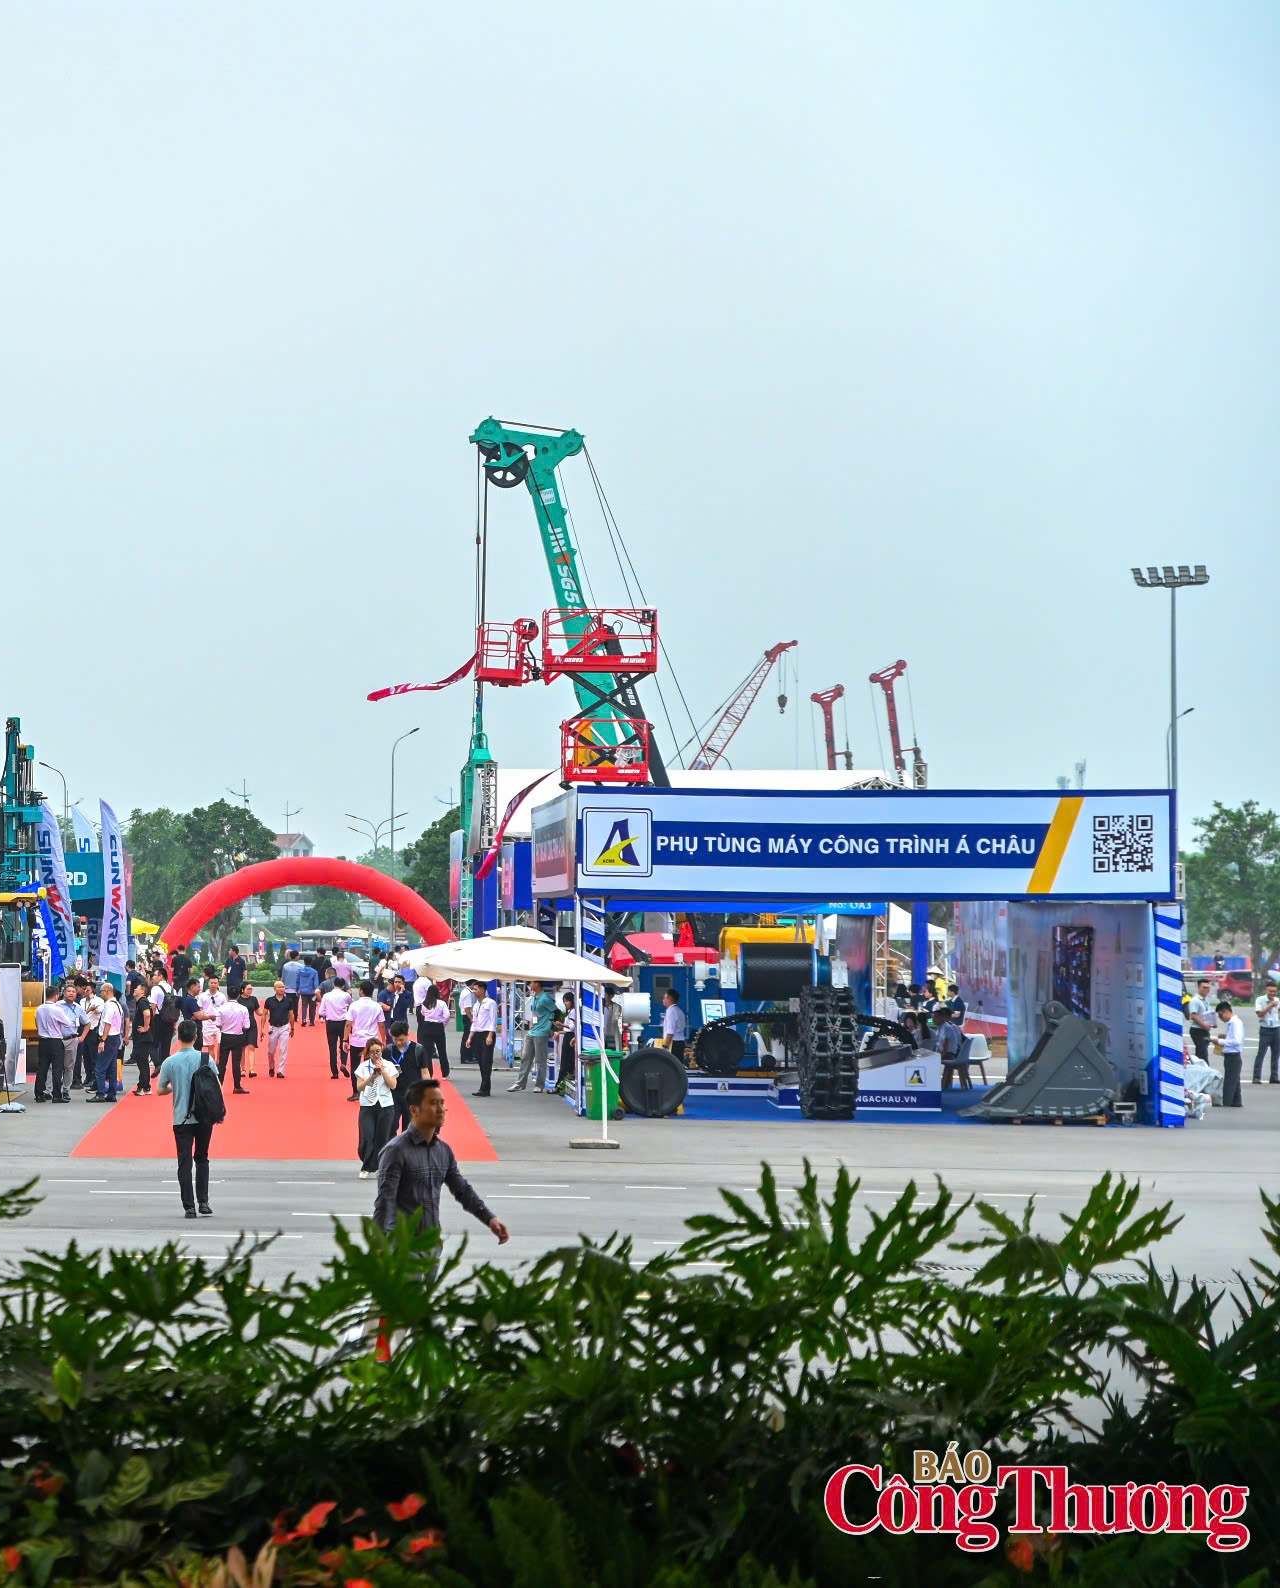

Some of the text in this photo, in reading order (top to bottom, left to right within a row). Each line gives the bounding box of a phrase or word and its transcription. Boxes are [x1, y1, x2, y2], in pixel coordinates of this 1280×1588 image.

[656, 833, 1035, 855] PHỤ TÙNG MÁY CÔNG TRÌNH Á CHÂU
